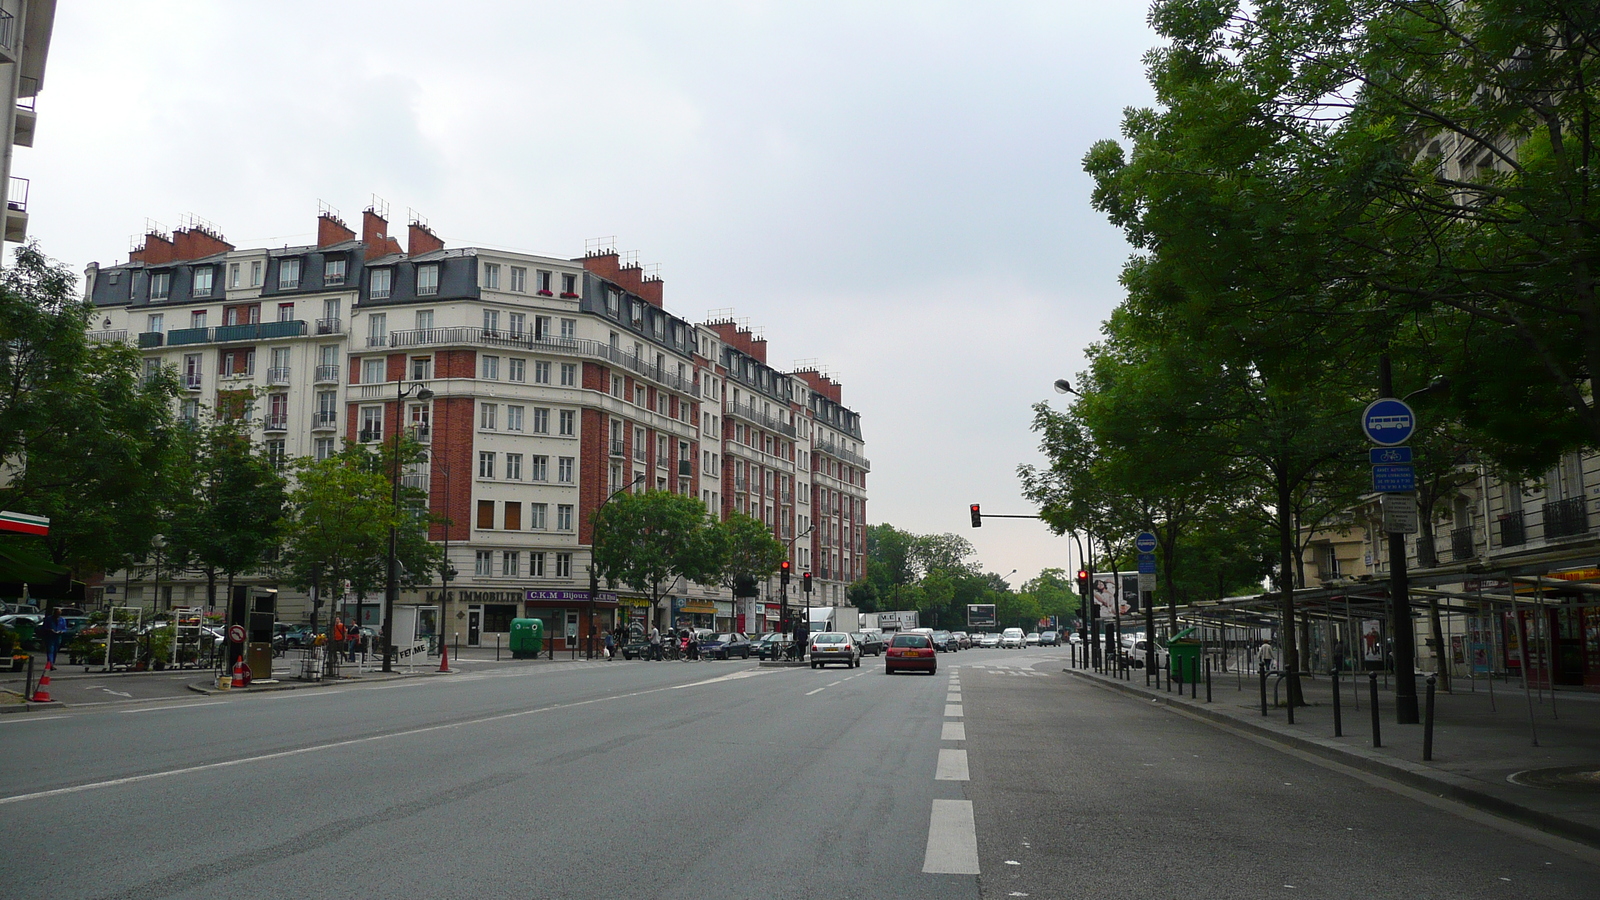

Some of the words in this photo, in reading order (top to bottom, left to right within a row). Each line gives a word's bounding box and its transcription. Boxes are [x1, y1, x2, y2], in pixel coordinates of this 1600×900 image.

[459, 591, 524, 602] IMMOBILIER
[530, 591, 558, 599] C.K.M
[562, 591, 588, 600] Bijoux
